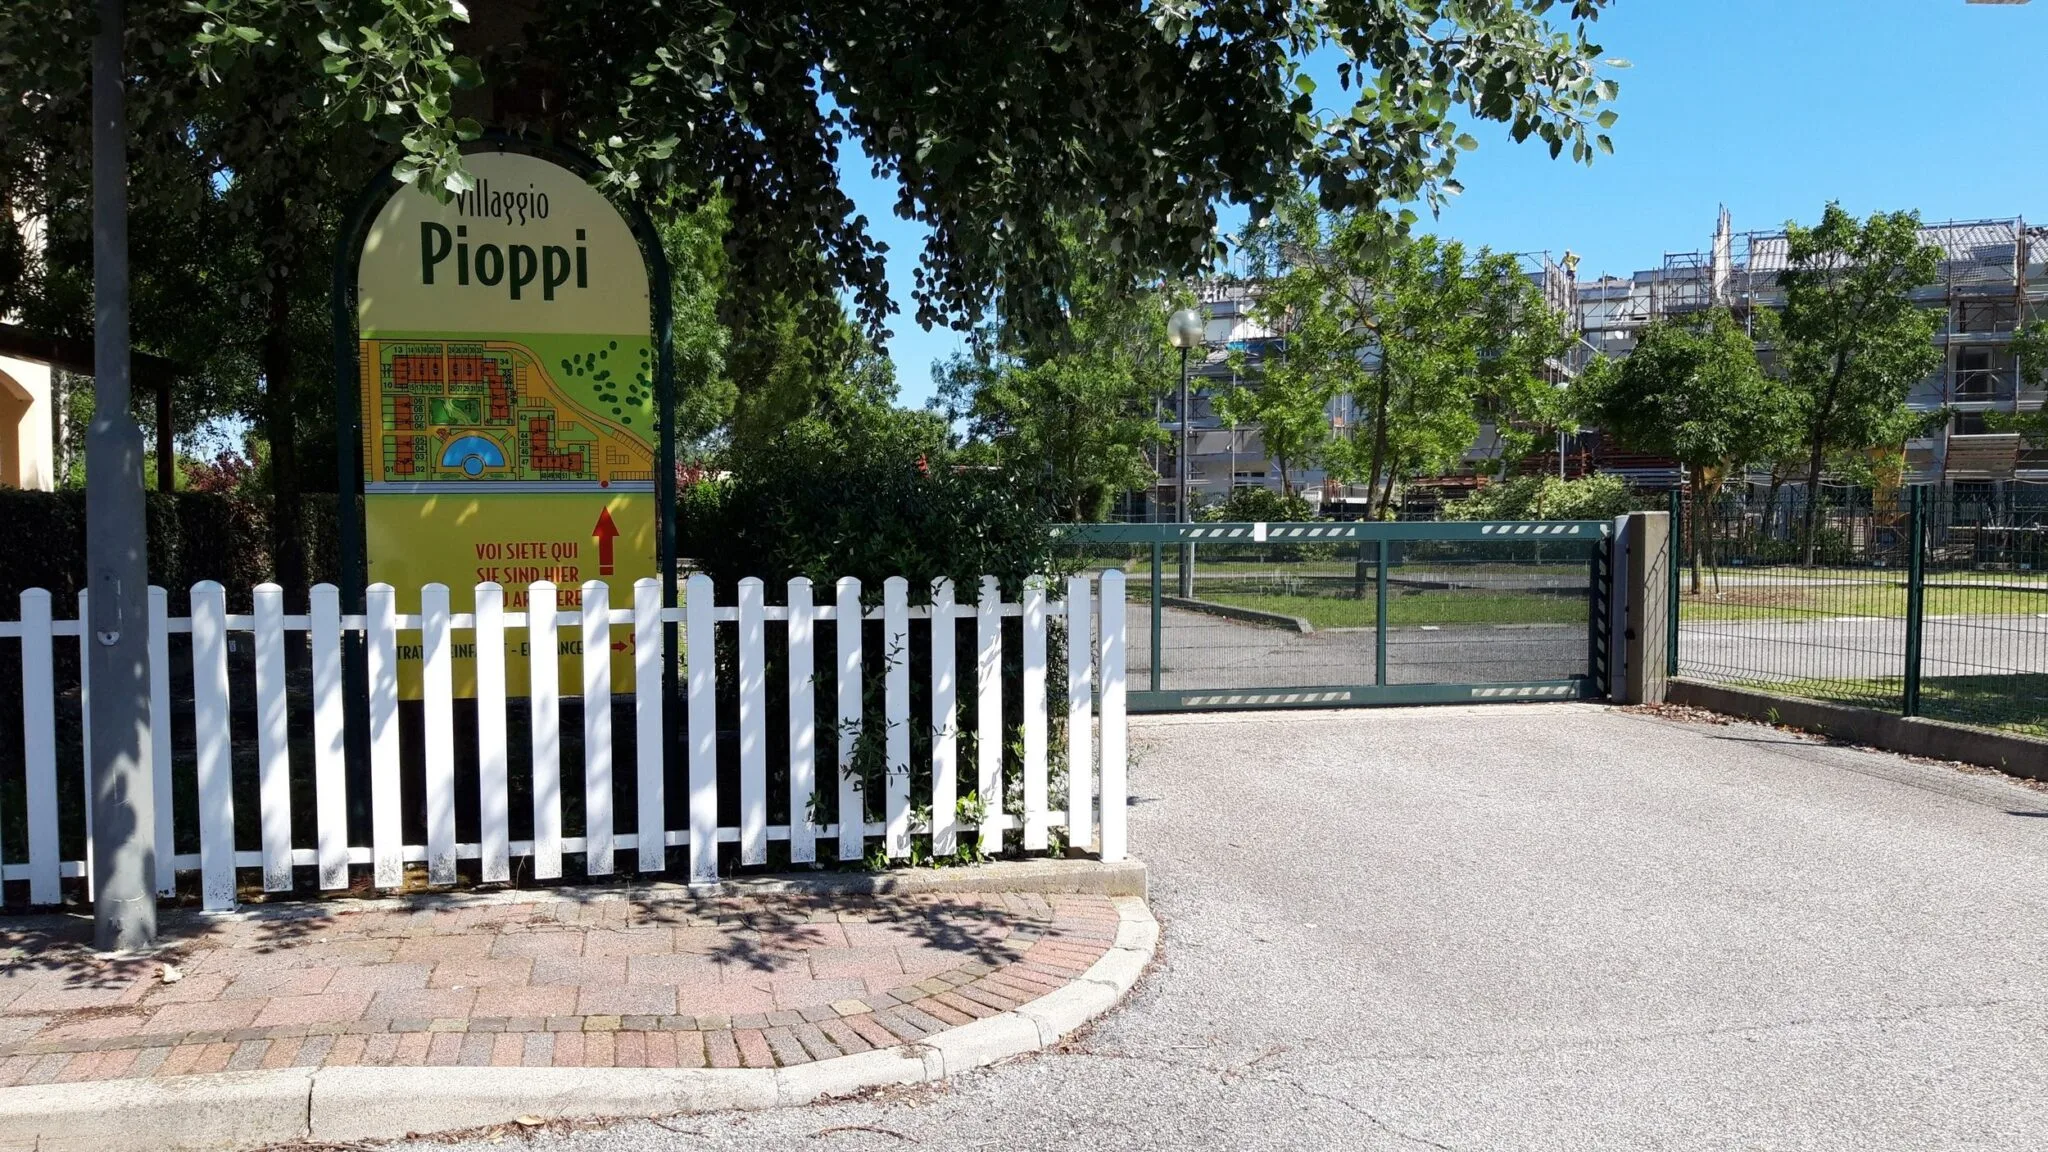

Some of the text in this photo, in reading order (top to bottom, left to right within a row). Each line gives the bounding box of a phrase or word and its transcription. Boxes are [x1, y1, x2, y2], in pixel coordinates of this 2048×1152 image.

[455, 178, 549, 226] Villaggio
[420, 221, 588, 301] Pioppi
[476, 542, 578, 562] VOI SIETE QUI
[476, 566, 580, 584] SIE SIND HIER
[556, 589, 582, 606] ERE
